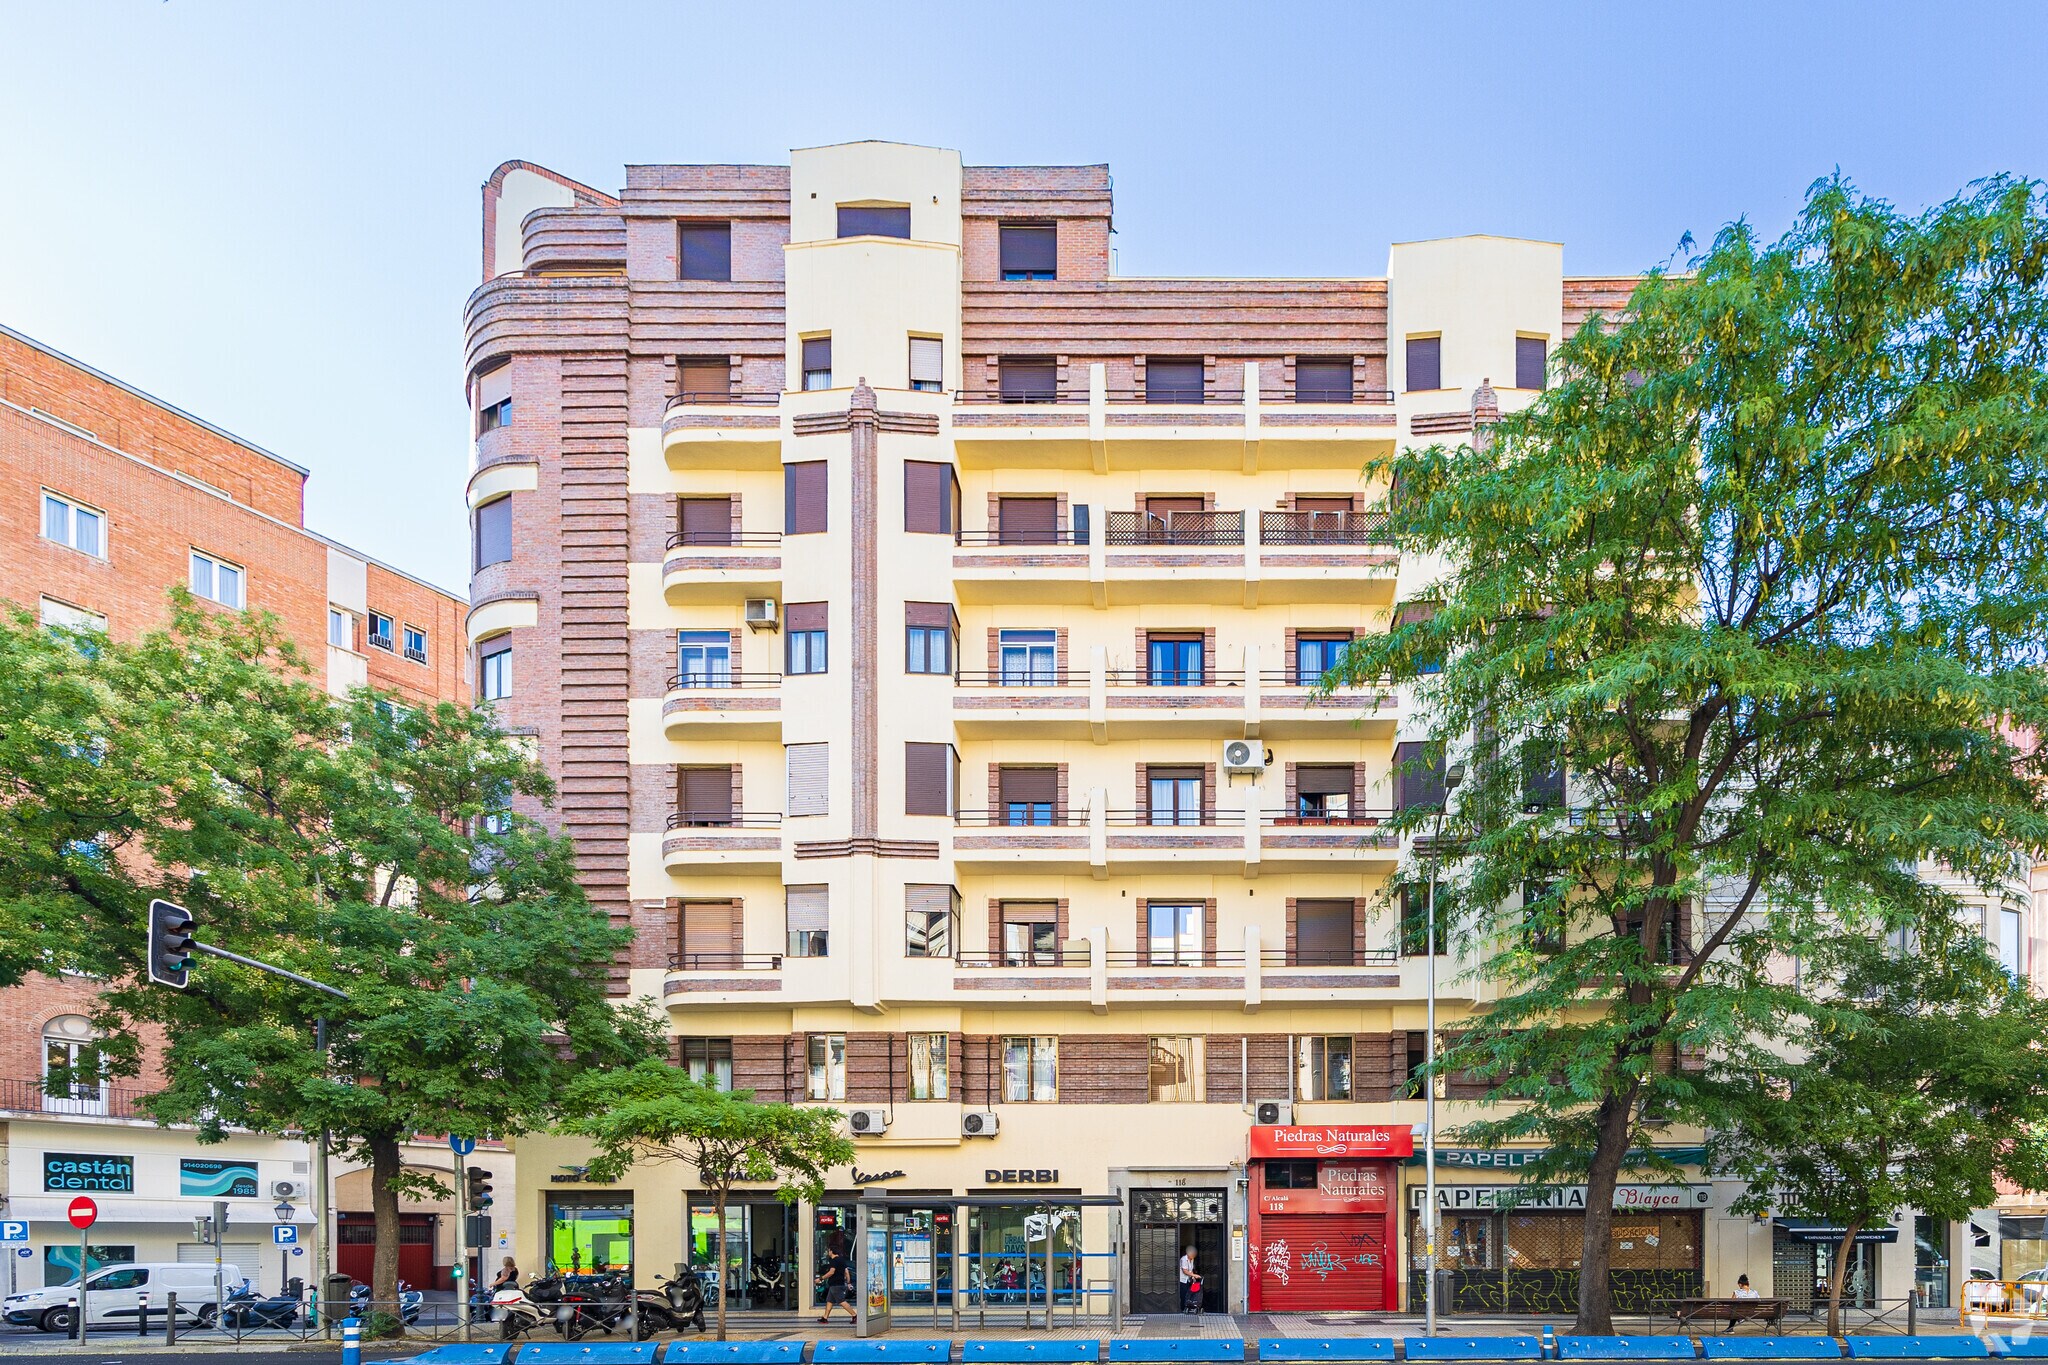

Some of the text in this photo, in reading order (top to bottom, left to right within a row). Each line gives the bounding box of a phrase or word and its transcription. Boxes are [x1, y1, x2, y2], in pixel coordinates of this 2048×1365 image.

[1274, 1129, 1390, 1142] Piedras Naturales
[48, 1160, 131, 1175] castán
[48, 1173, 131, 1190] dental
[550, 1174, 580, 1183] MOTO
[851, 1166, 907, 1185] Vespa
[985, 1169, 1059, 1183] DERBI
[1175, 1178, 1187, 1186] 118
[1328, 1169, 1377, 1182] Piedras
[1320, 1183, 1385, 1196] Naturales
[1619, 1188, 1679, 1208] Blayca
[1269, 1202, 1284, 1211] 118
[4, 1222, 23, 1240] P
[278, 1227, 293, 1242] P
